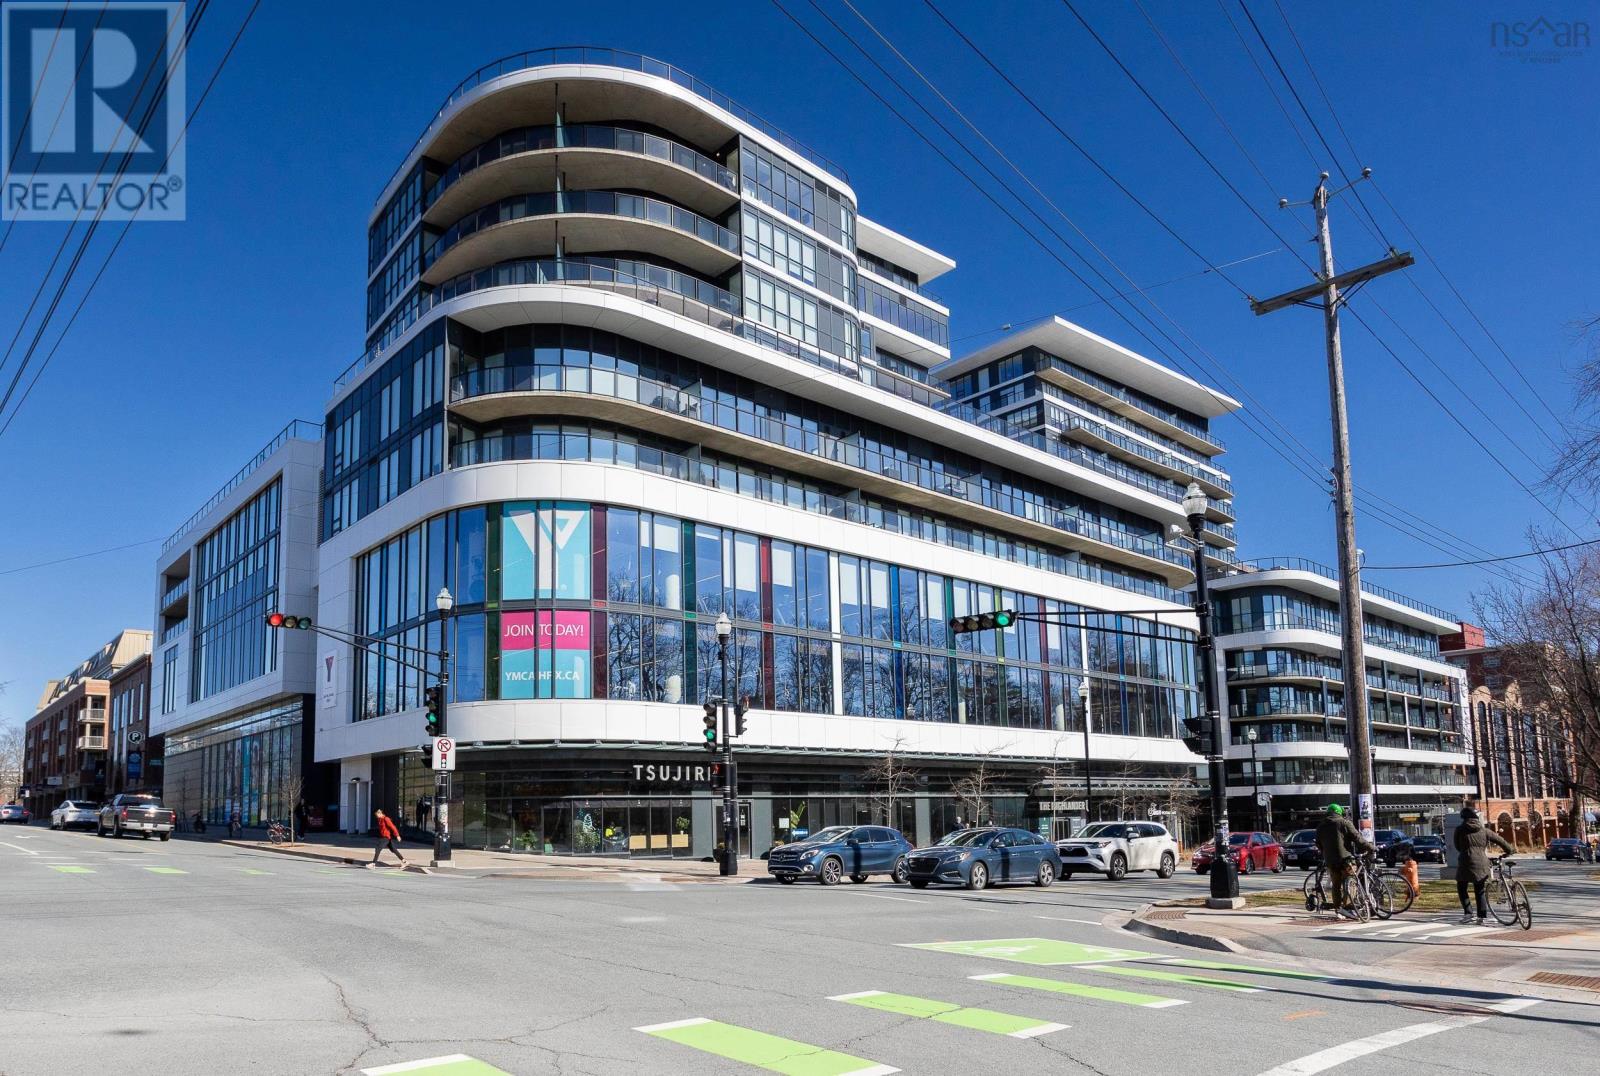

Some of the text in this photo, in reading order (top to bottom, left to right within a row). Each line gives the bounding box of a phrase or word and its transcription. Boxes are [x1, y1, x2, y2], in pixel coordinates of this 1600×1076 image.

[504, 623, 584, 637] JOIN TODAY!
[633, 764, 711, 782] TSUJIRI
